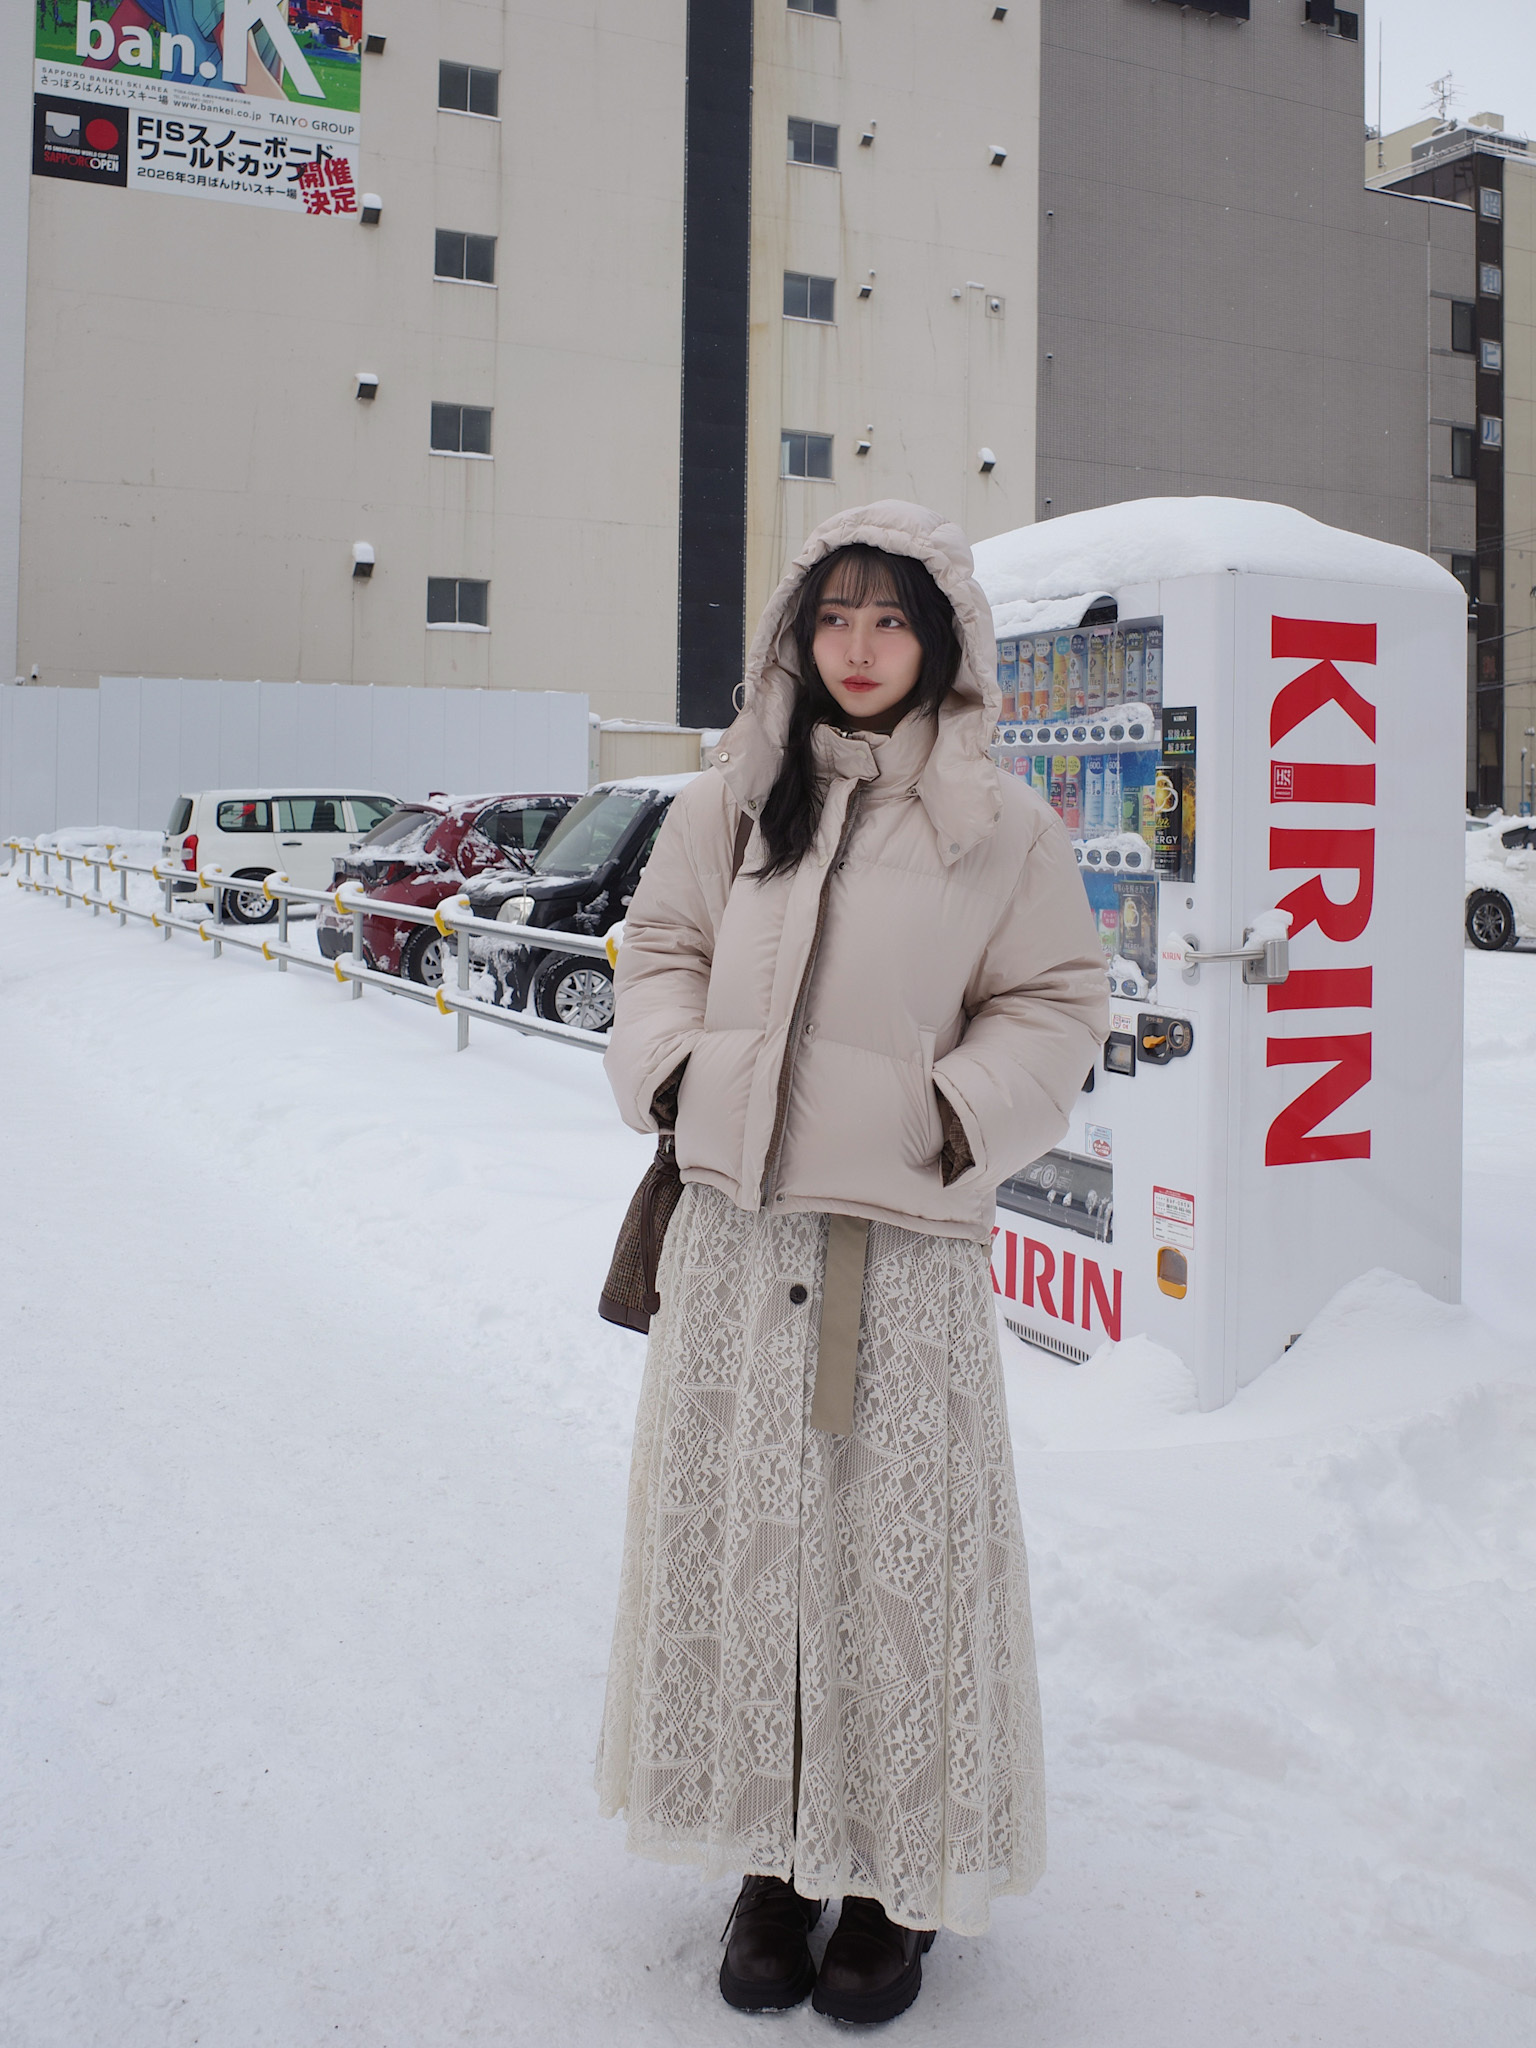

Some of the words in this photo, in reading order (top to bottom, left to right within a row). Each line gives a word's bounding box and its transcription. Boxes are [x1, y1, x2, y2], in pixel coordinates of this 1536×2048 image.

[41, 66, 86, 80] SAPPORO
[89, 74, 123, 87] BANKEI
[126, 81, 142, 90] SKI
[144, 84, 169, 94] AREA
[41, 75, 169, 106] さっぽろばんけいスキー場
[173, 100, 262, 121] www.bankei.co.jp
[269, 112, 308, 128] TAIYO
[311, 120, 355, 135] GROUP
[137, 116, 333, 164] FISスノーボード
[90, 157, 119, 172] OPEN
[137, 138, 308, 182] ワールドカップ
[297, 157, 354, 190] 開催
[136, 166, 298, 200] 2026年3月ばんけいスキー場
[302, 187, 358, 216] 決定
[1482, 191, 1500, 442] 昭和ビル
[1265, 614, 1377, 1167] KIRIN
[1162, 953, 1184, 963] KIRIN
